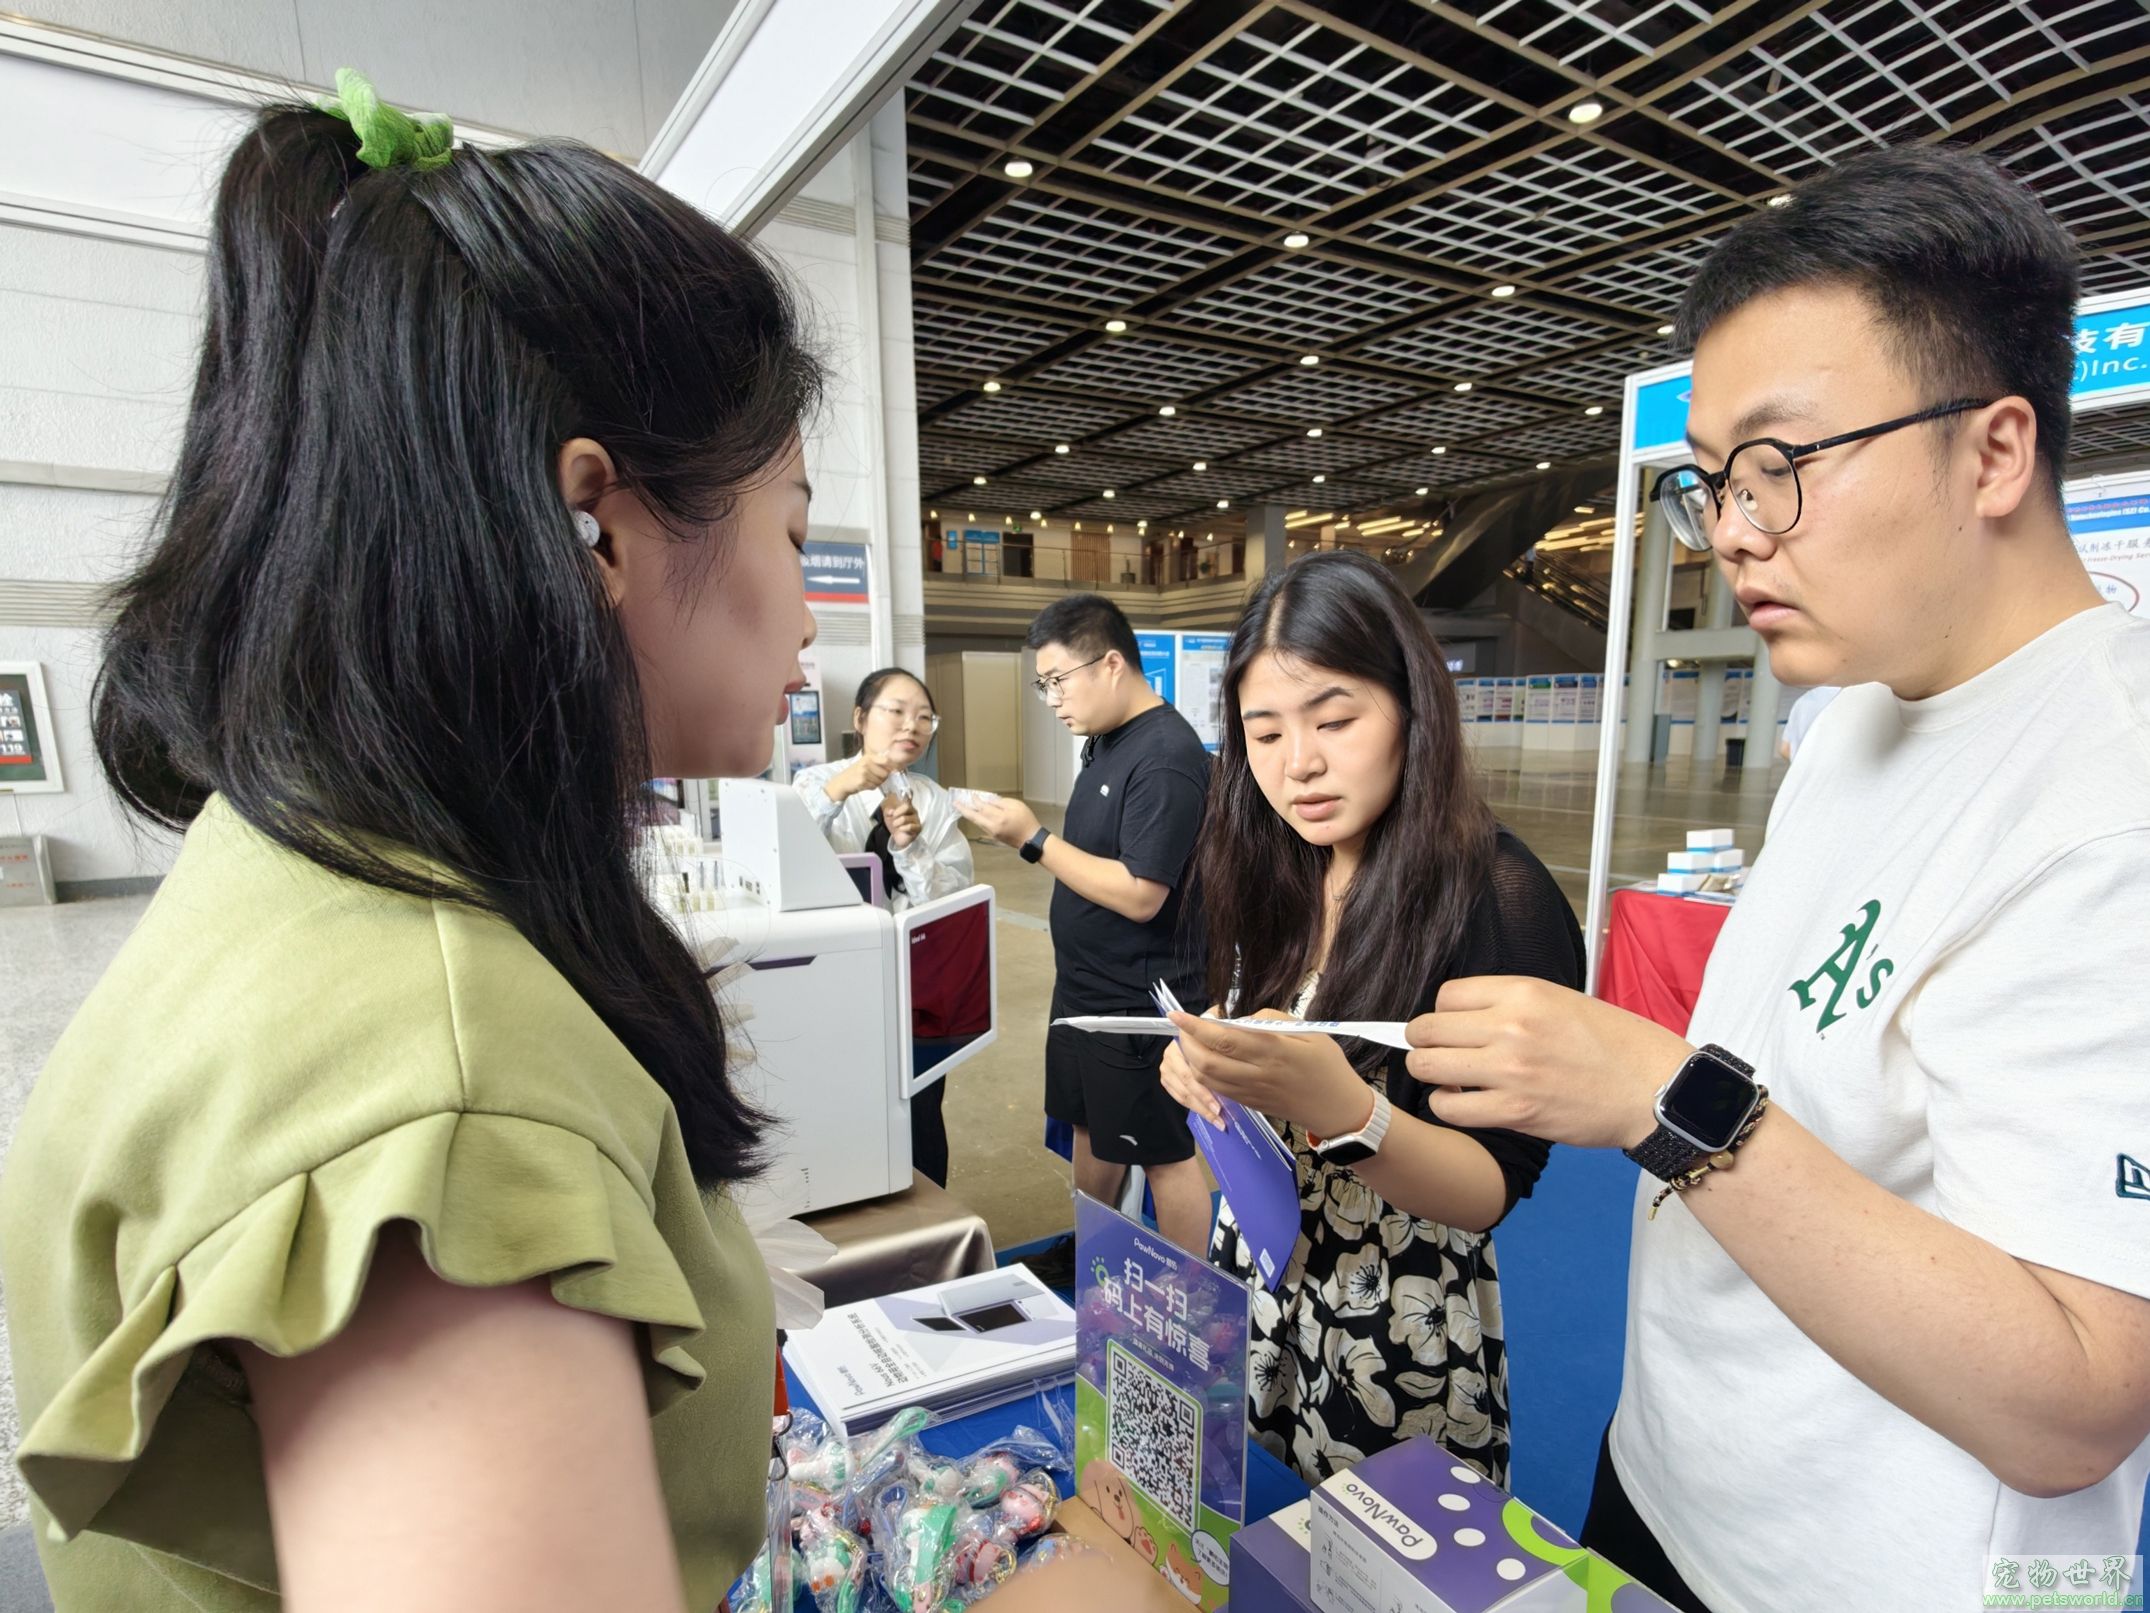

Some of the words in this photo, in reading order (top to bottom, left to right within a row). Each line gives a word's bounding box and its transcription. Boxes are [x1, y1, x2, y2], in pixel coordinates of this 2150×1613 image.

[1124, 1257, 1188, 1321] 扫一扫
[1103, 1277, 1210, 1371] 码上有惊喜
[1346, 1483, 1423, 1547] PawNovo
